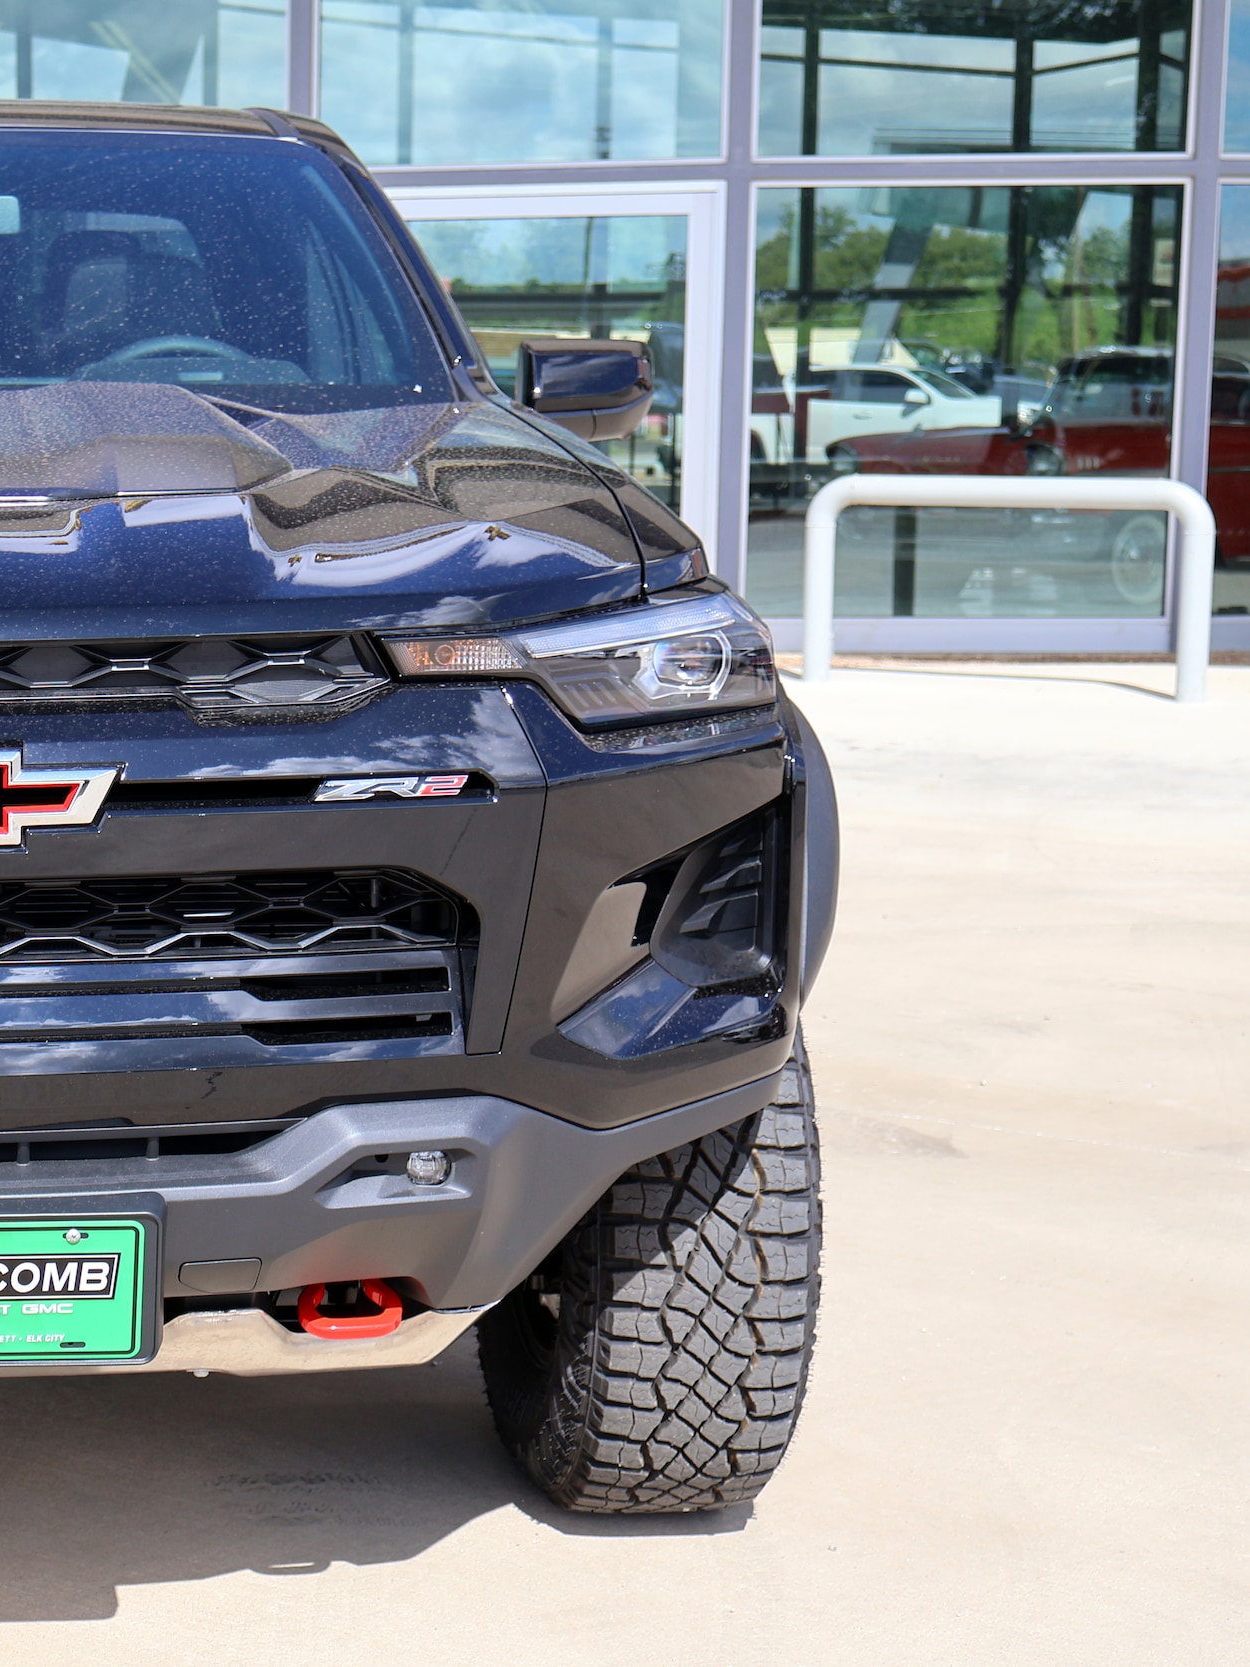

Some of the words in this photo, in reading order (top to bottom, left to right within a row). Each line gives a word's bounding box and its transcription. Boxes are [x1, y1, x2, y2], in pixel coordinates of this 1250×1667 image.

[314, 774, 469, 802] ZR2
[21, 1302, 74, 1315] GMC
[25, 1333, 43, 1343] ELK
[44, 1333, 66, 1343] CITY
